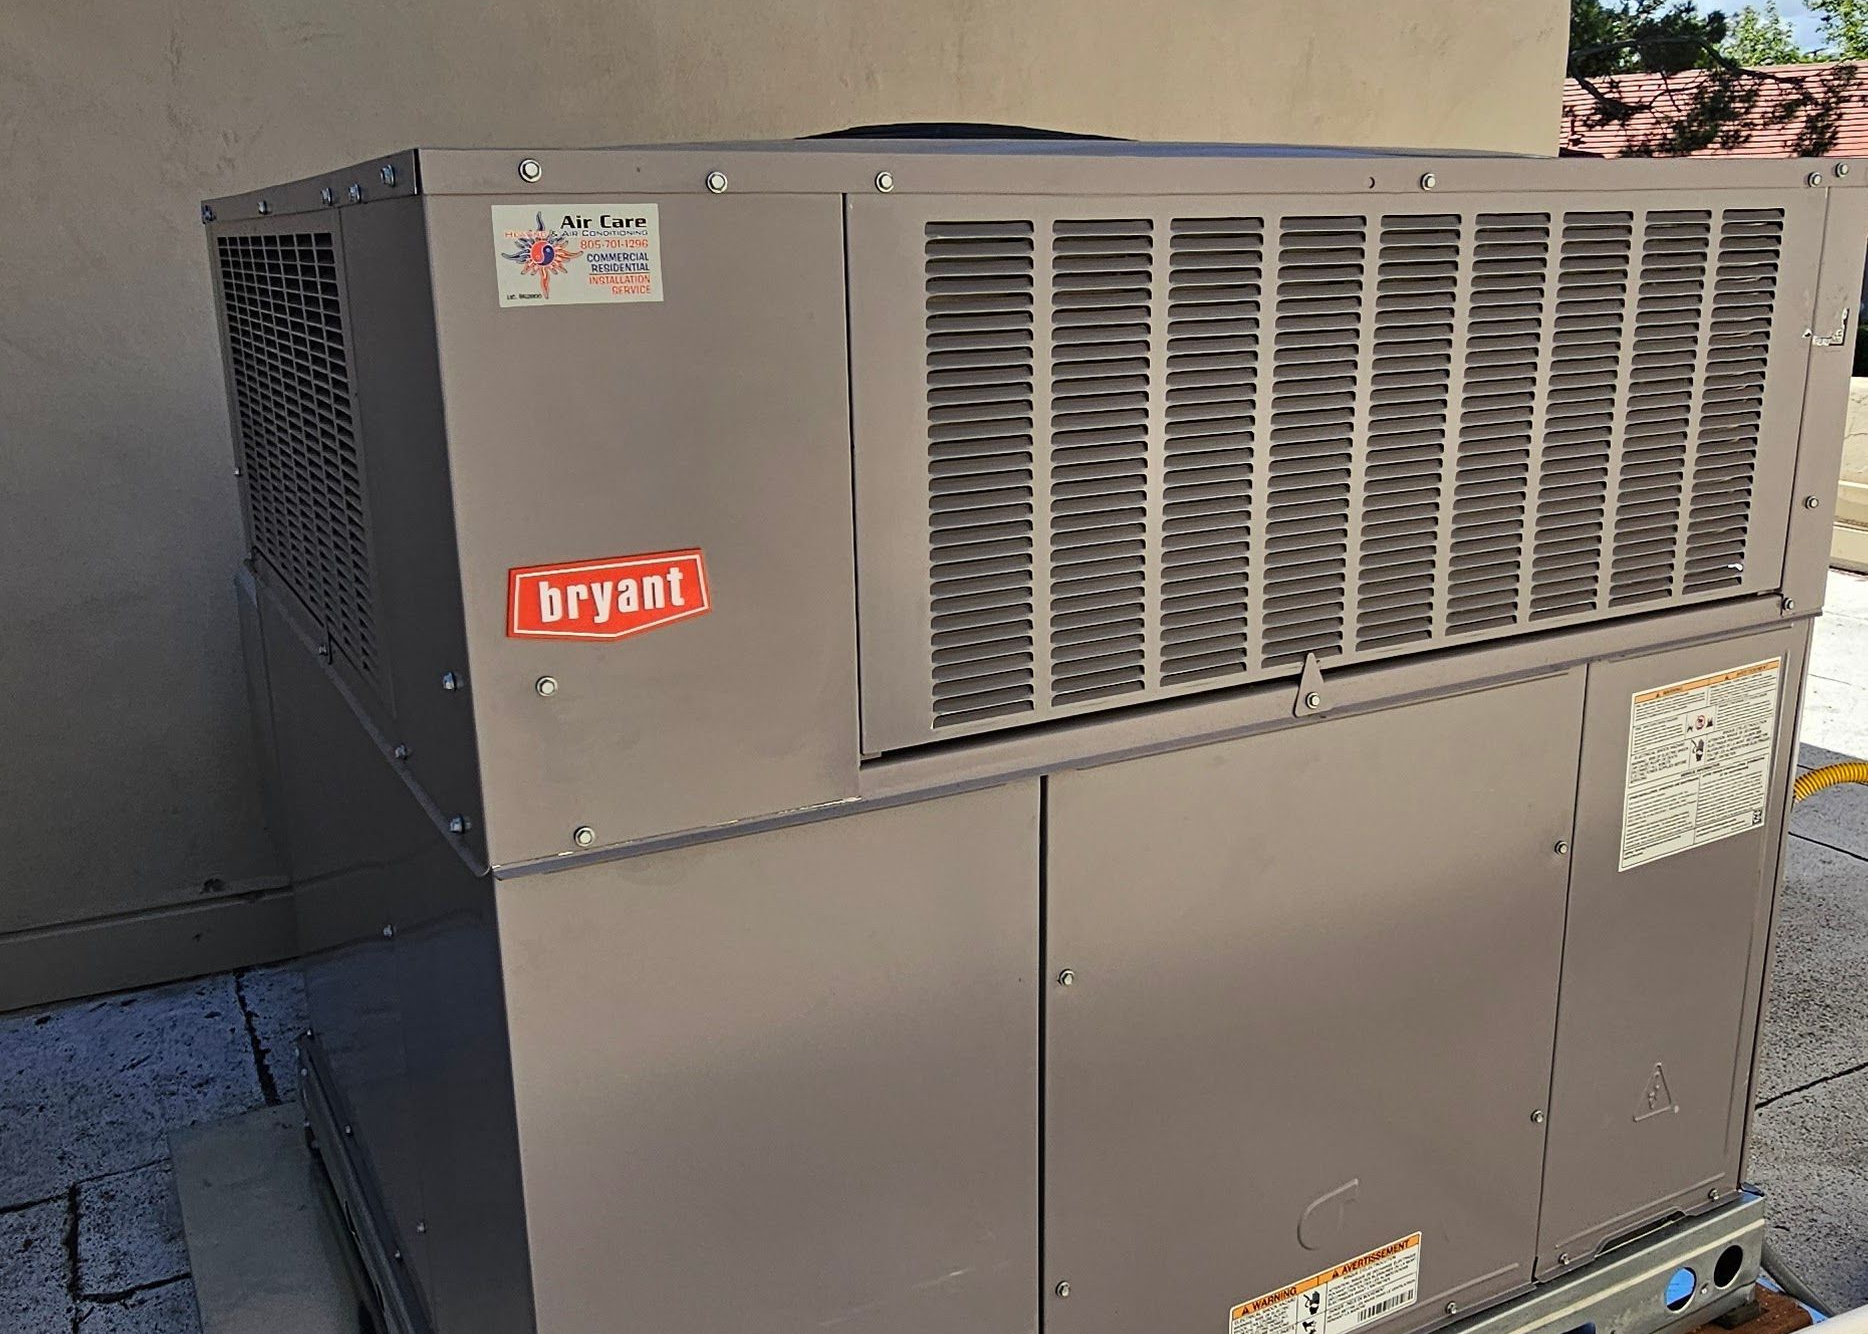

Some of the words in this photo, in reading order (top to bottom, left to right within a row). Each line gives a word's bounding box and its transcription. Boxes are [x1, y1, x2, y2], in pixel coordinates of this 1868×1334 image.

[560, 215, 592, 229] Air
[600, 215, 647, 228] Care
[580, 239, 648, 249] 805-701-1296
[587, 252, 649, 262] COMMERCIAL
[591, 263, 650, 273] RESIDENTIAL
[589, 275, 651, 284] INSTALLATION
[612, 285, 651, 294] SERVICE
[538, 567, 685, 623] bryant
[1341, 1239, 1410, 1274] AVERTISSEMENT
[1252, 1287, 1297, 1310] WARNING
